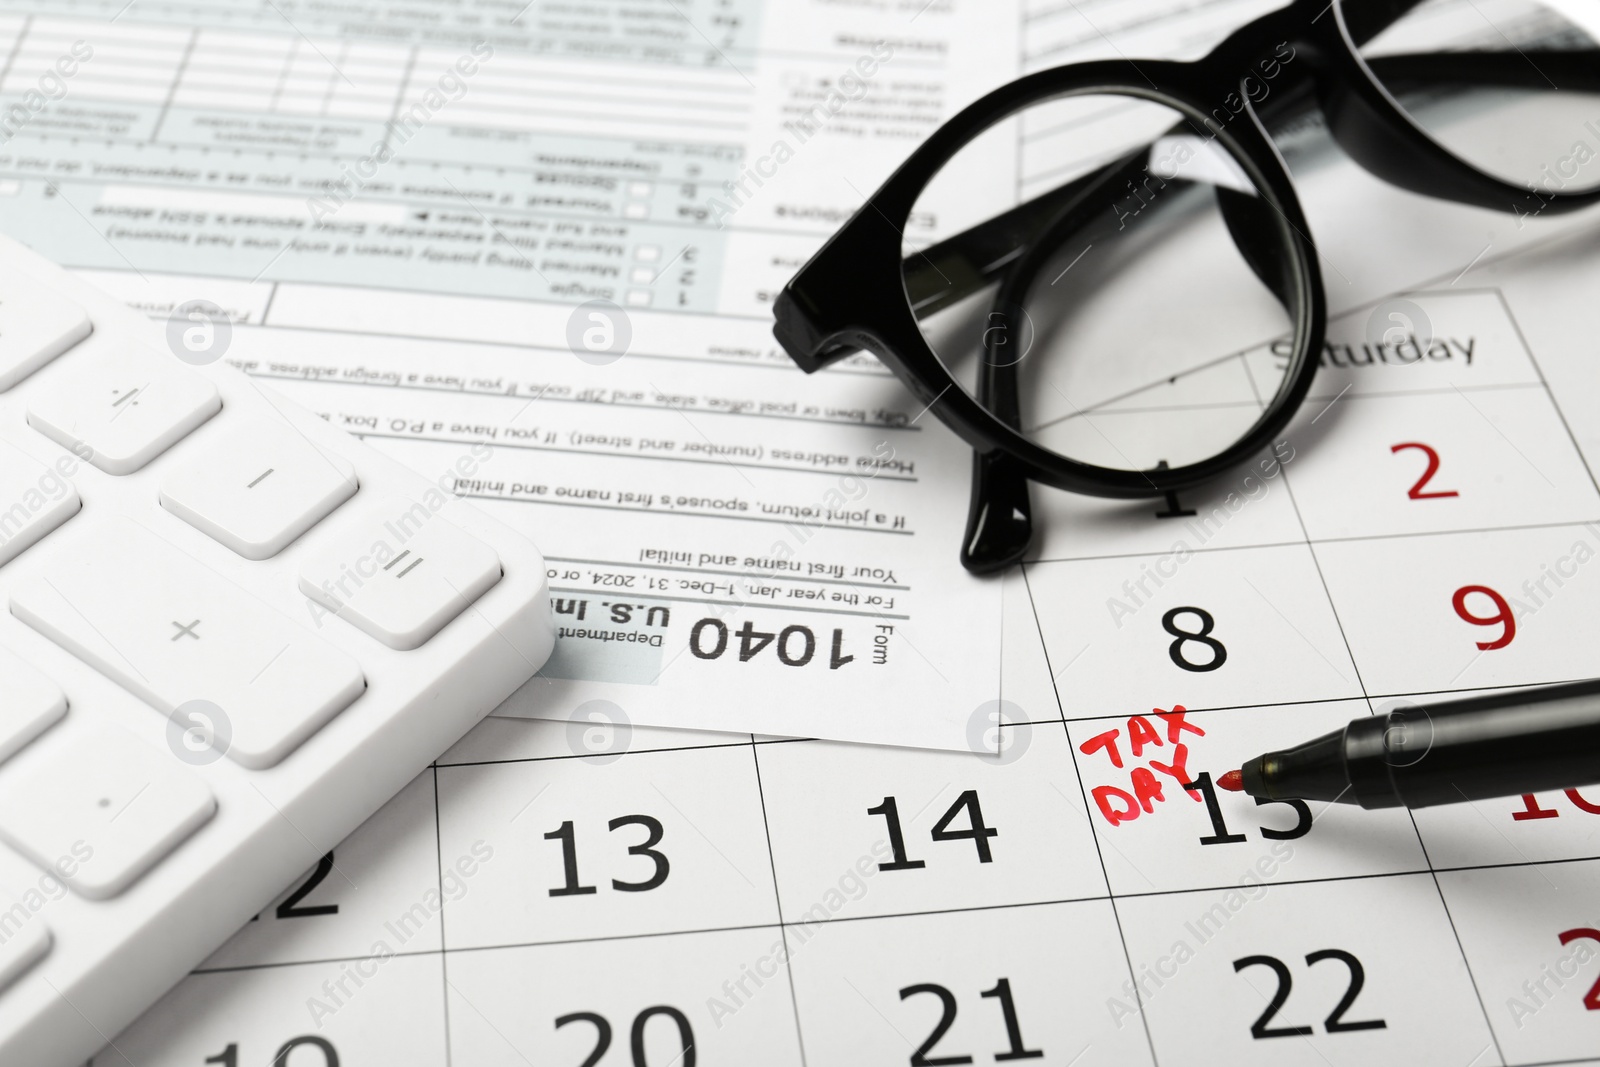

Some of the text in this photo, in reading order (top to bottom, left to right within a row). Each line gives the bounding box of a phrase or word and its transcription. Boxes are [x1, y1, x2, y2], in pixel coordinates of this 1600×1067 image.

[548, 282, 616, 301] Single
[1270, 333, 1475, 369] Sturday
[342, 367, 402, 387] foreign
[423, 375, 466, 393] have
[470, 377, 503, 391] you
[575, 388, 607, 404] ZIP
[611, 390, 645, 405] and
[759, 401, 798, 418] post
[802, 405, 820, 418] or
[823, 407, 867, 424] town
[338, 413, 379, 430] box,
[386, 417, 426, 434] P.O.
[450, 422, 498, 440] have
[503, 426, 540, 439] you
[543, 432, 558, 445] If
[638, 438, 675, 455] and
[681, 441, 765, 462] (number
[770, 449, 849, 469] address
[855, 455, 915, 474] Home
[1390, 441, 1460, 501] 2
[452, 478, 906, 529] If a joint return, spouse's first name and initial
[638, 548, 897, 584] Your first name and initial
[561, 571, 580, 581] or
[587, 570, 636, 588] 2024,
[642, 575, 668, 591] 31,
[744, 585, 782, 600] Jan.
[786, 585, 826, 599] year
[831, 592, 859, 607] the
[863, 595, 895, 609] For
[602, 602, 670, 627] U.S.
[1451, 584, 1517, 651] 9
[558, 627, 663, 647] Department
[689, 618, 853, 670] 1040
[872, 625, 894, 665] Form
[1161, 606, 1228, 672] 8
[1080, 704, 1206, 768] TAX
[1091, 744, 1203, 827] DAY
[867, 790, 999, 871] 14
[543, 814, 671, 897] 13
[1232, 948, 1388, 1040] 22
[898, 977, 1045, 1067] 21
